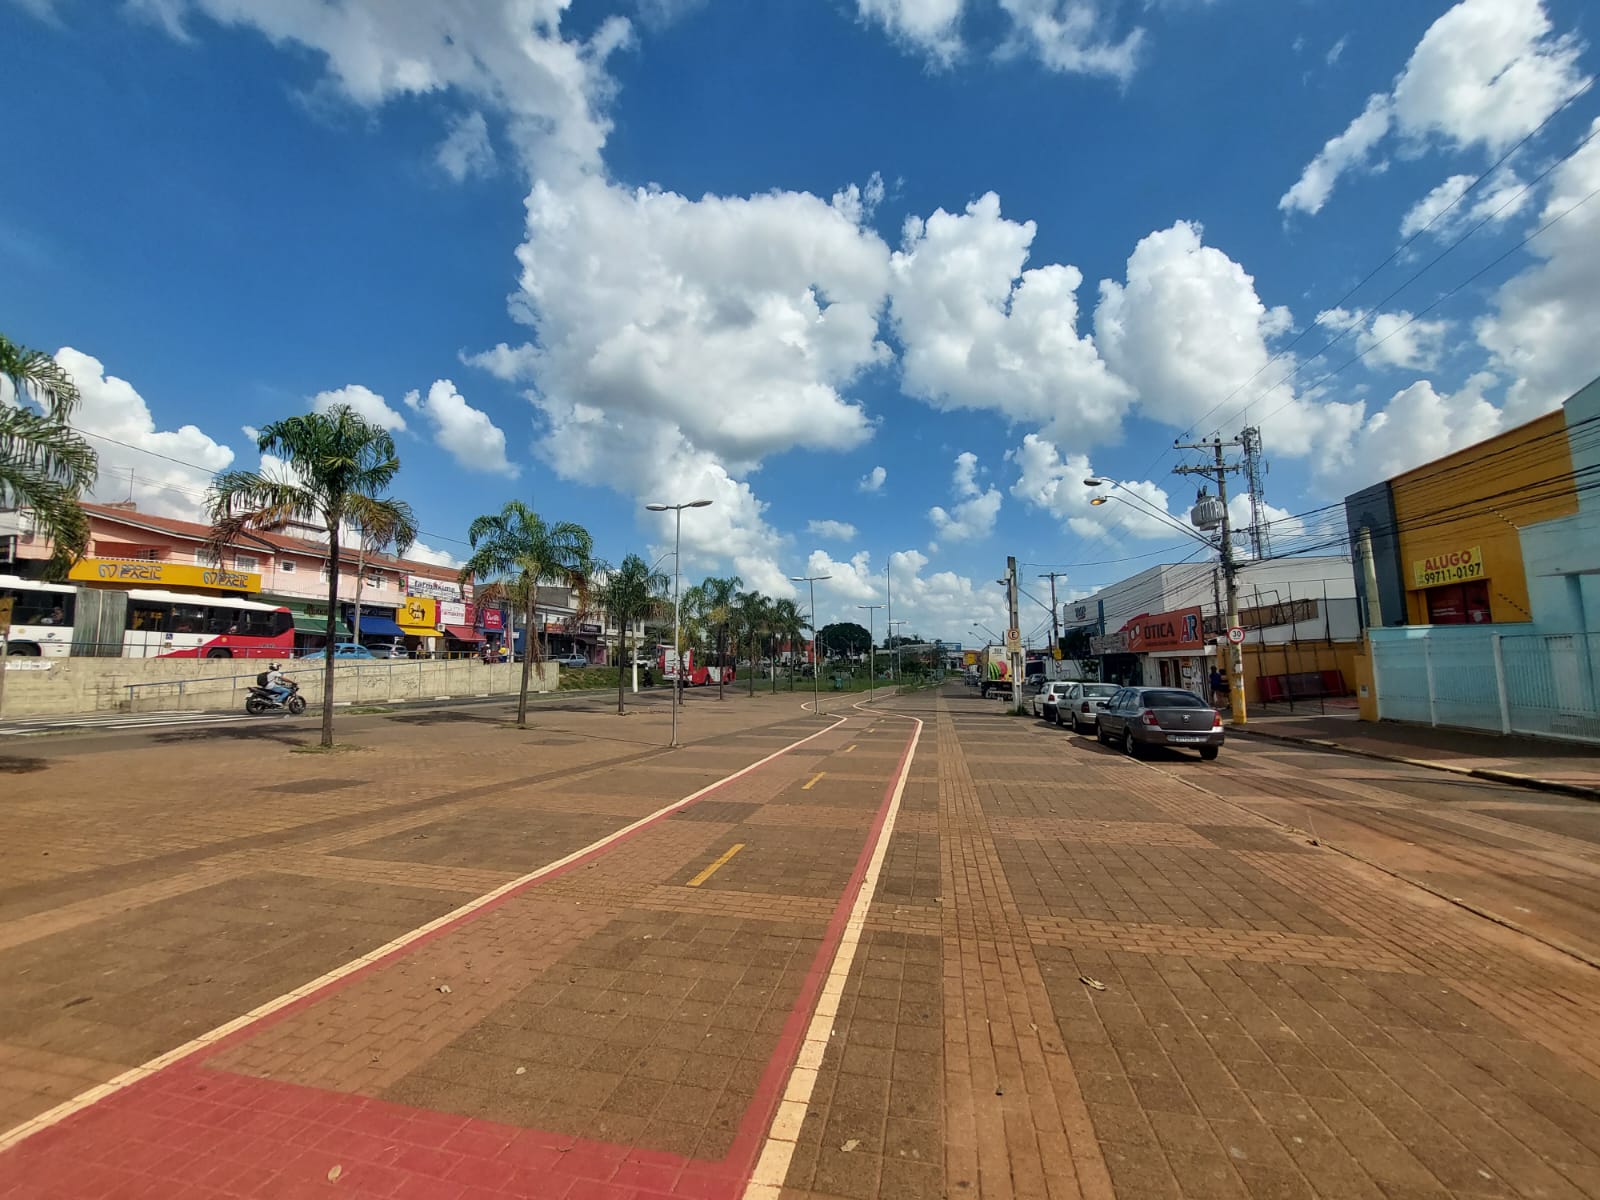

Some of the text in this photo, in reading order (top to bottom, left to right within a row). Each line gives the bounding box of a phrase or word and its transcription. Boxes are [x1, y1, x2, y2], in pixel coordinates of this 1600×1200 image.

[1425, 551, 1471, 571] ALUGO
[1424, 562, 1481, 584] 99711-0197
[1011, 631, 1017, 639] E
[1232, 630, 1242, 638] 30
